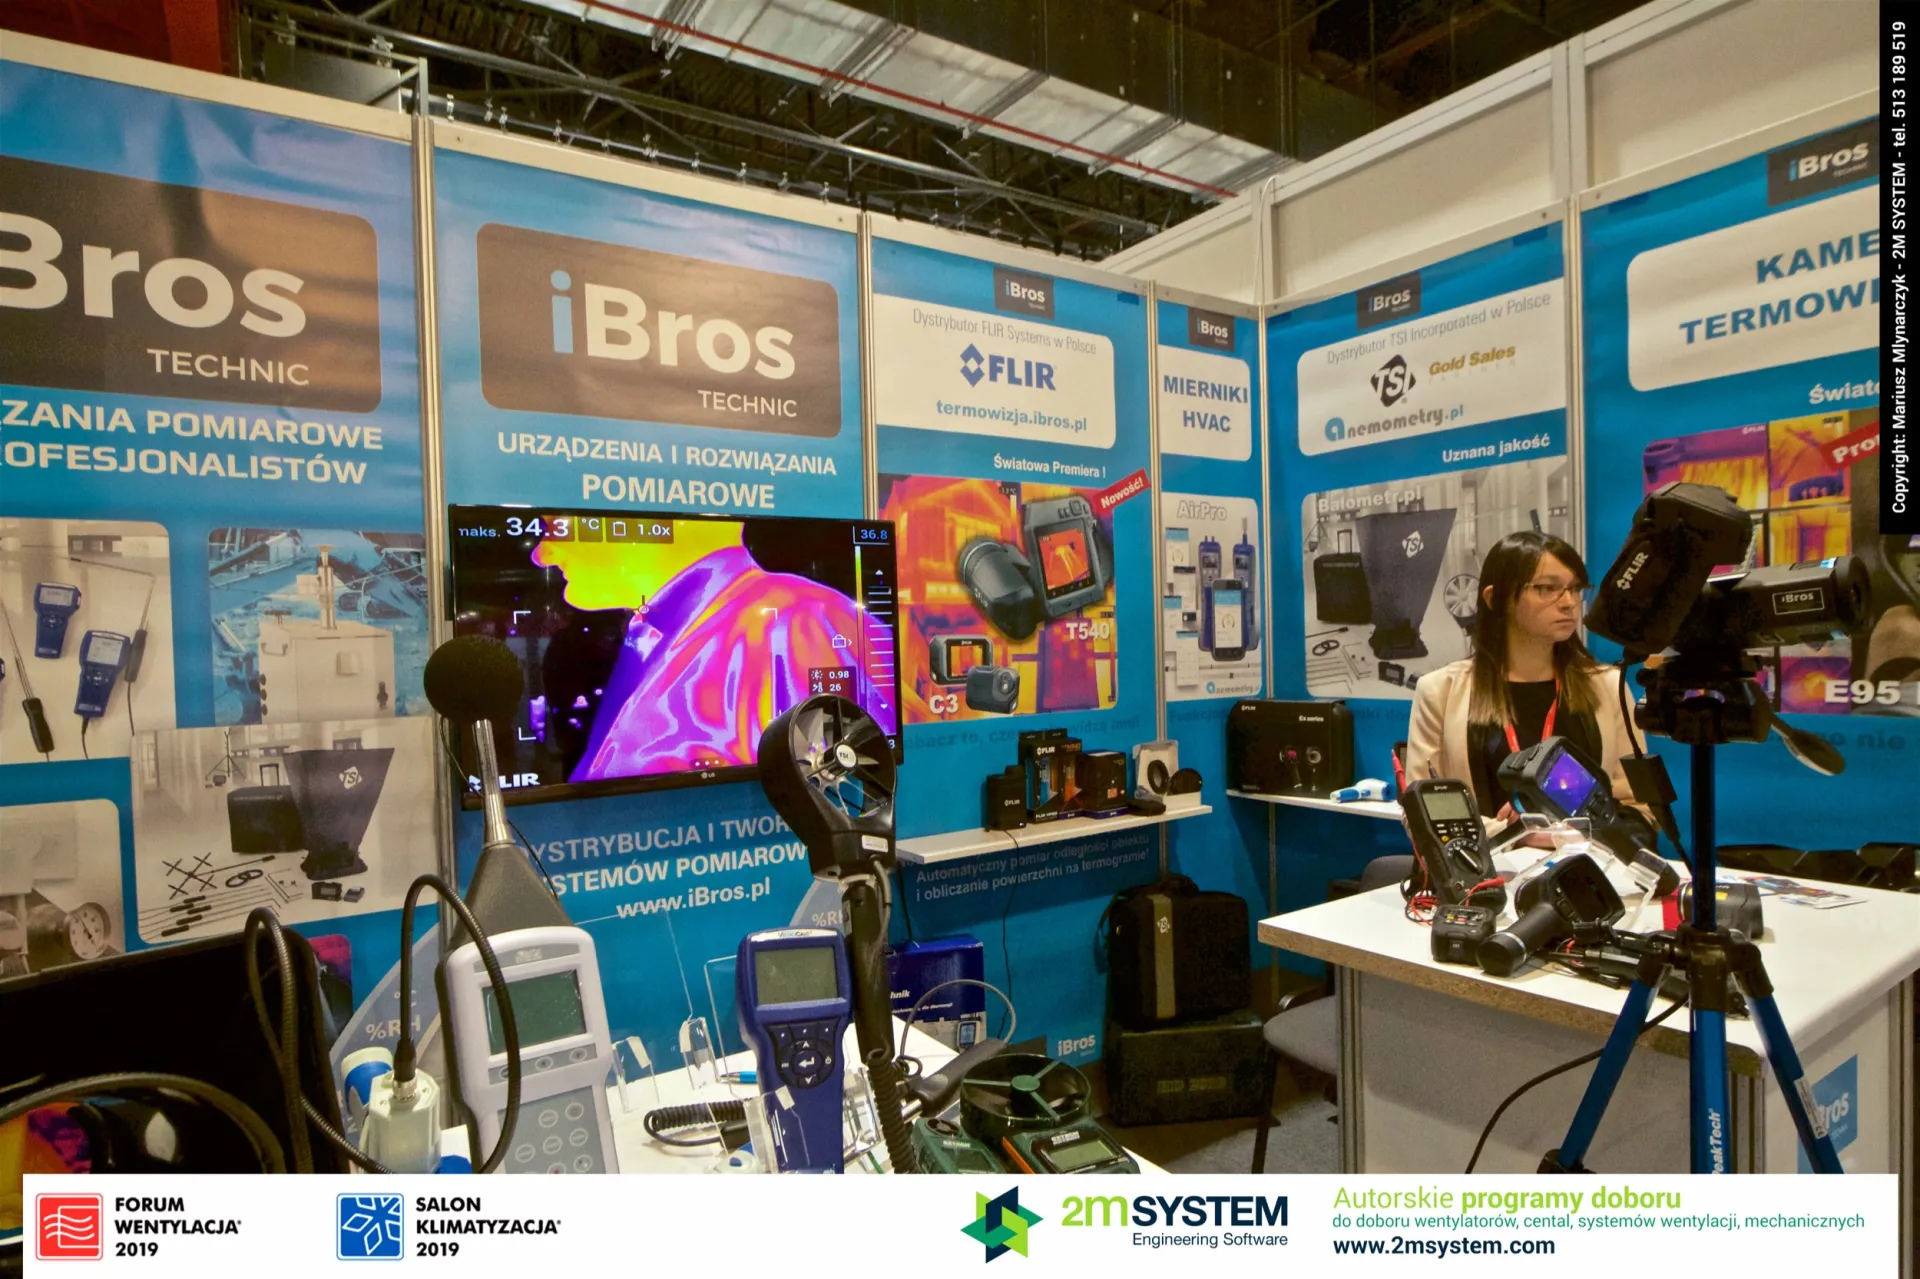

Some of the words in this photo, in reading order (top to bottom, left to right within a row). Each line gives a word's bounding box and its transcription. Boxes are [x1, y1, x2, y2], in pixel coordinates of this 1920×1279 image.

[1789, 142, 1869, 182] iBros
[1757, 229, 1880, 284] KAME
[1005, 279, 1046, 303] iBros
[1369, 288, 1411, 313] iBros
[550, 269, 796, 380] iBros
[913, 308, 978, 334] Dystrybutor
[982, 321, 1004, 339] FLIR
[1007, 327, 1051, 348] Systems
[1053, 337, 1063, 349] w
[1066, 336, 1096, 355] Polsce
[1197, 318, 1229, 339] iBros
[1327, 337, 1386, 364] Dystrybutor
[1391, 329, 1408, 347] TSI
[1411, 311, 1486, 341] Incorporated
[1491, 307, 1502, 319] w
[1506, 294, 1550, 317] Polsce
[147, 349, 309, 387] TECHNIC
[988, 353, 1056, 391] FLIR
[1428, 354, 1465, 377] Gold
[1469, 345, 1516, 367] Sales
[1163, 374, 1249, 404] MIERNIKI
[1373, 362, 1413, 401] TSI
[697, 389, 798, 418] TECHNIC
[936, 400, 1087, 434] termowizja.ibros.pl
[0, 400, 136, 434] ZANIA
[147, 411, 384, 451] POMIAROWE
[1183, 409, 1232, 433] HVAC
[1324, 404, 1464, 442] anemometry.pl
[0, 440, 367, 485] OFESJONALISTÓW
[498, 432, 663, 464] URZĄDZENIA
[672, 445, 678, 465] I
[687, 445, 837, 477] ROZWIĄZANIA
[1442, 442, 1496, 463] Uznana
[1498, 432, 1550, 457] jakość
[994, 453, 1050, 473] Światowa
[1053, 461, 1100, 479] Premiera
[582, 474, 775, 509] POMIAROWE
[1101, 477, 1144, 510] Nowość!
[1318, 485, 1422, 513] Balometr.pl
[1177, 500, 1228, 521] AirPro
[506, 516, 569, 537] 34.3
[581, 518, 600, 530] °C
[638, 524, 670, 536] 1.0x
[860, 529, 888, 541] 36.8
[1625, 551, 1649, 582] FLIR
[1781, 591, 1814, 604] iBros
[1066, 622, 1110, 641] T540
[829, 670, 850, 679] 0.98
[829, 683, 841, 692] 26
[929, 694, 958, 714] C3
[1824, 679, 1901, 705] E95
[1041, 746, 1055, 755] FLIR
[499, 772, 540, 789] LIR
[709, 823, 714, 842] I
[916, 857, 1007, 883] Automatyczny
[1010, 851, 1050, 872] pomiar
[924, 879, 989, 900] obliczanie
[992, 864, 1063, 891] powierzchni
[1066, 864, 1079, 874] na
[1082, 848, 1150, 871] termogramie!
[616, 877, 770, 920] www.iBros.pl
[890, 989, 910, 999] hnik
[1058, 1034, 1096, 1057] iBros
